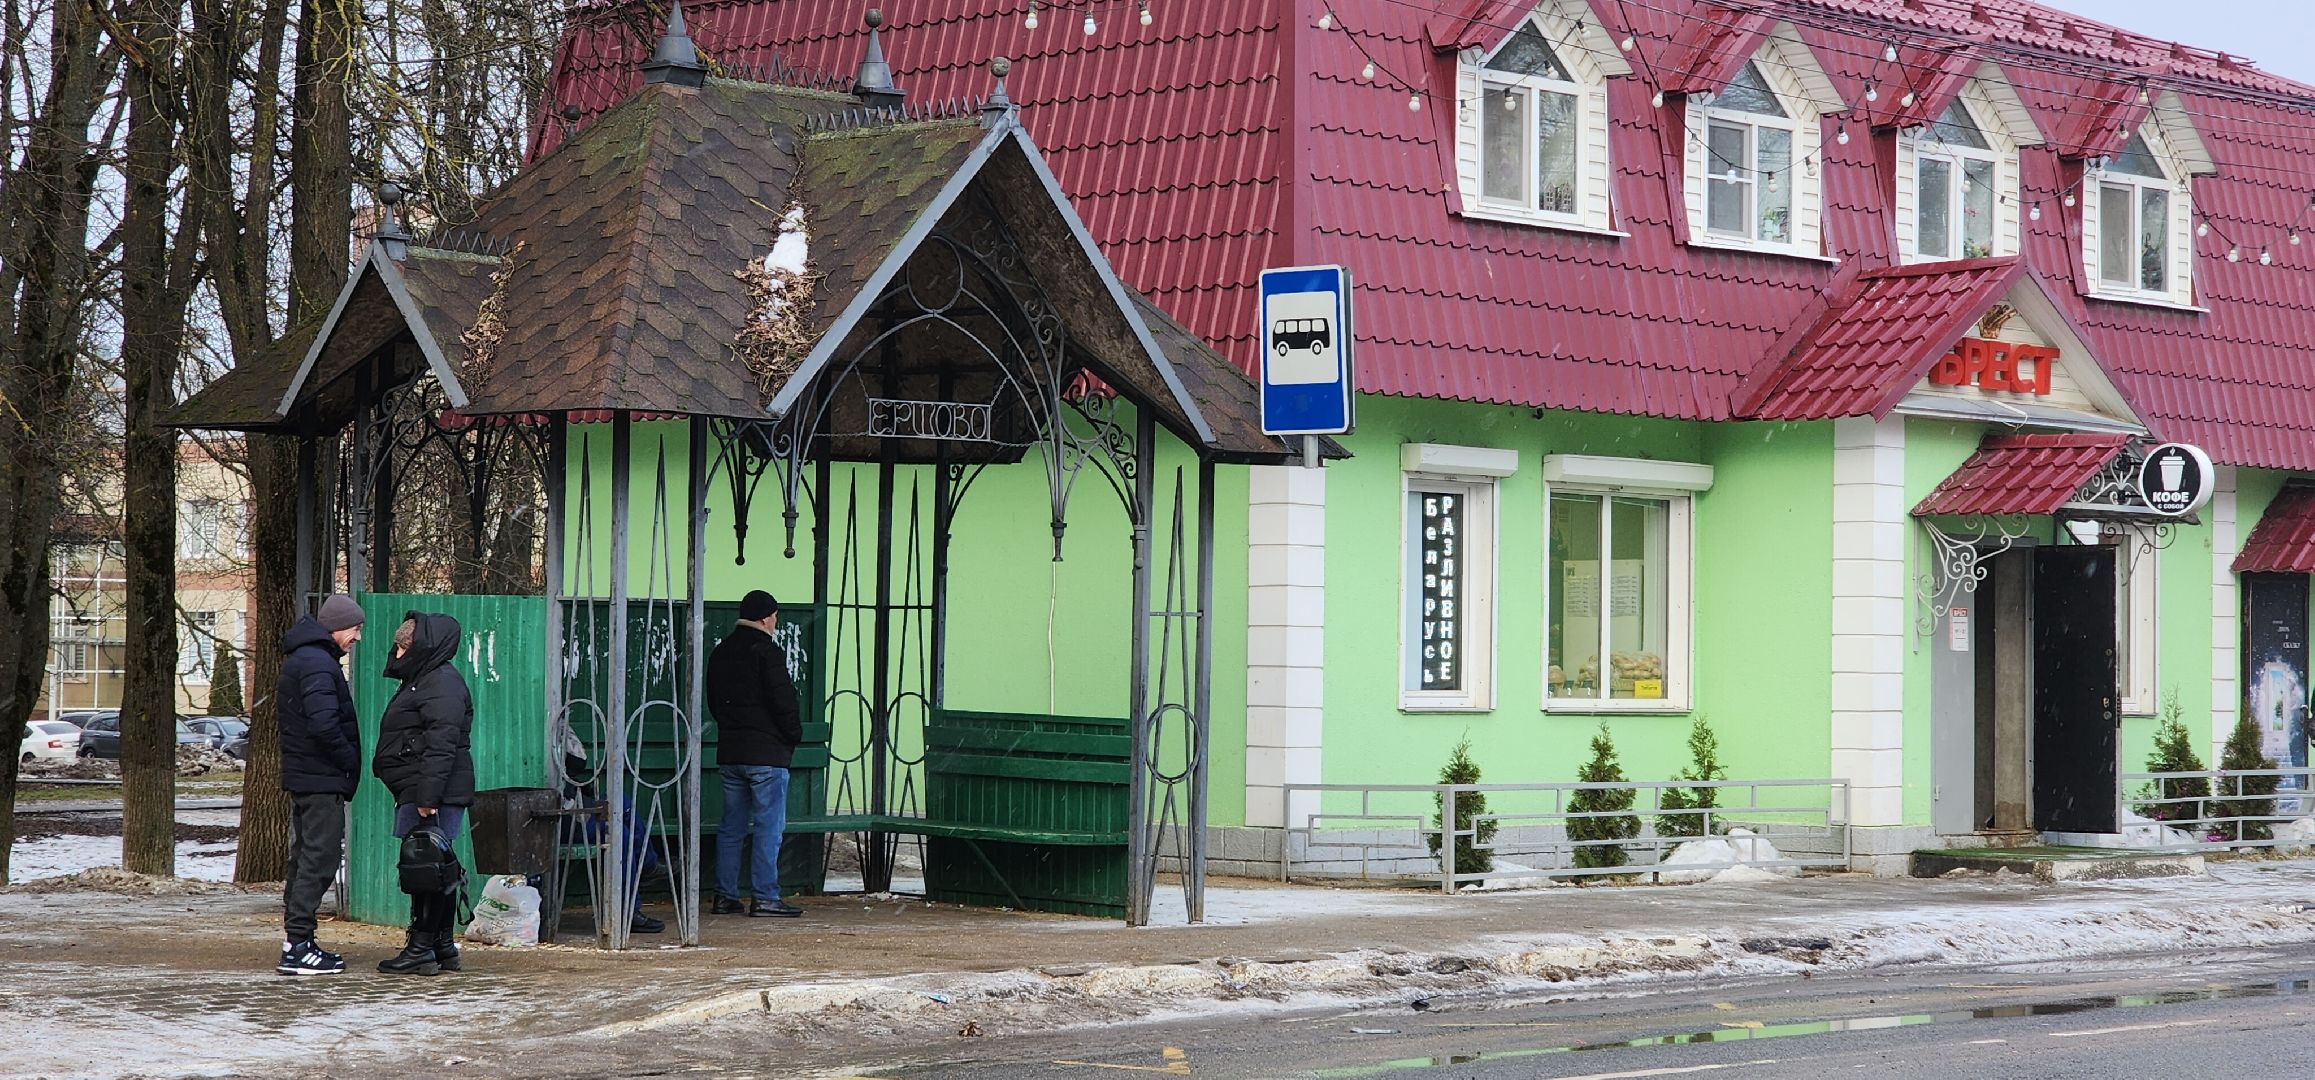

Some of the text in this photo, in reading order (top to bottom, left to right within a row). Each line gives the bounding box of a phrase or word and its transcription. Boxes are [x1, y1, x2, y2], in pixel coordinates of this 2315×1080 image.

[1928, 337, 2060, 396] БРЕСТ
[872, 401, 987, 439] ЕРШОВО
[2152, 491, 2189, 502] КОФЕ
[1440, 496, 1455, 680] РАЗЛИВНОЕ
